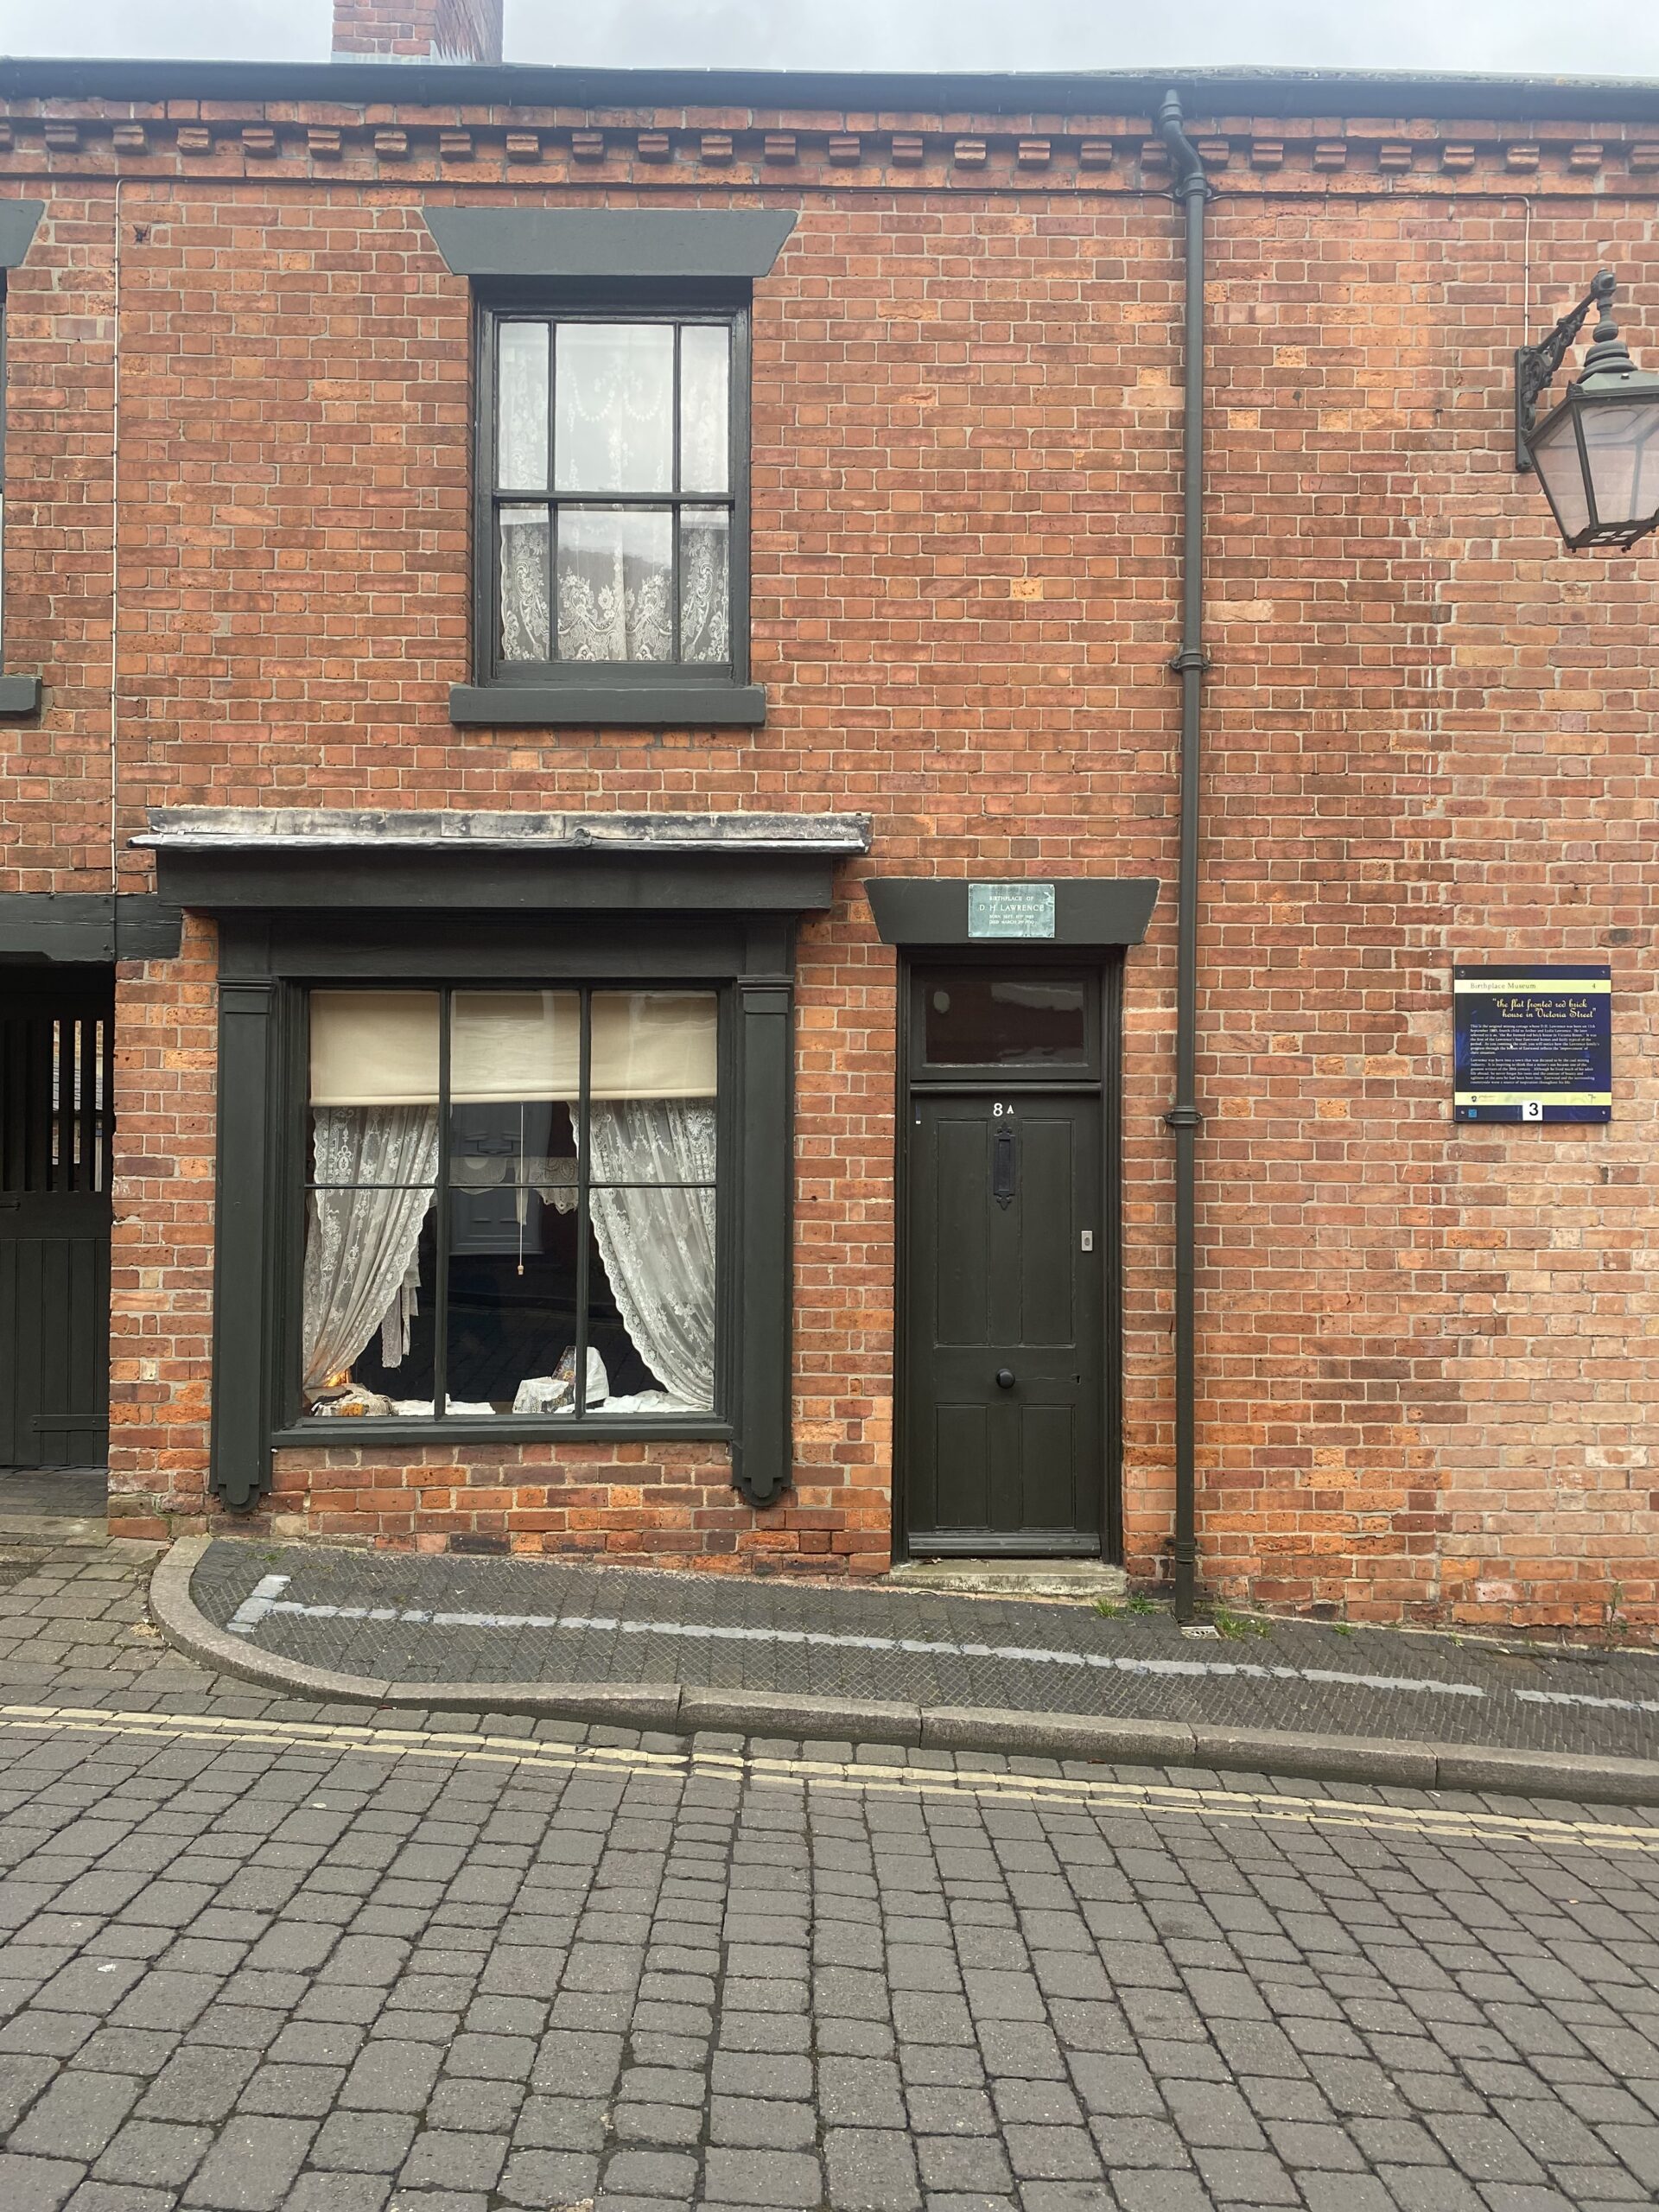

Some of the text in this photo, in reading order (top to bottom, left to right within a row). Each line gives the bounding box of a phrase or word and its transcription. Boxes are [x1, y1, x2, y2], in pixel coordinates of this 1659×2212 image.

[1470, 982, 1506, 990] Birthplace
[1510, 998, 1525, 1011] flat
[1526, 998, 1553, 1011] fronted
[1554, 998, 1567, 1007] red
[1568, 998, 1587, 1008] brick
[1502, 1007, 1524, 1018] house
[1526, 1008, 1534, 1018] in
[1535, 1007, 1567, 1018] Victoria
[1529, 1103, 1539, 1116] 3
